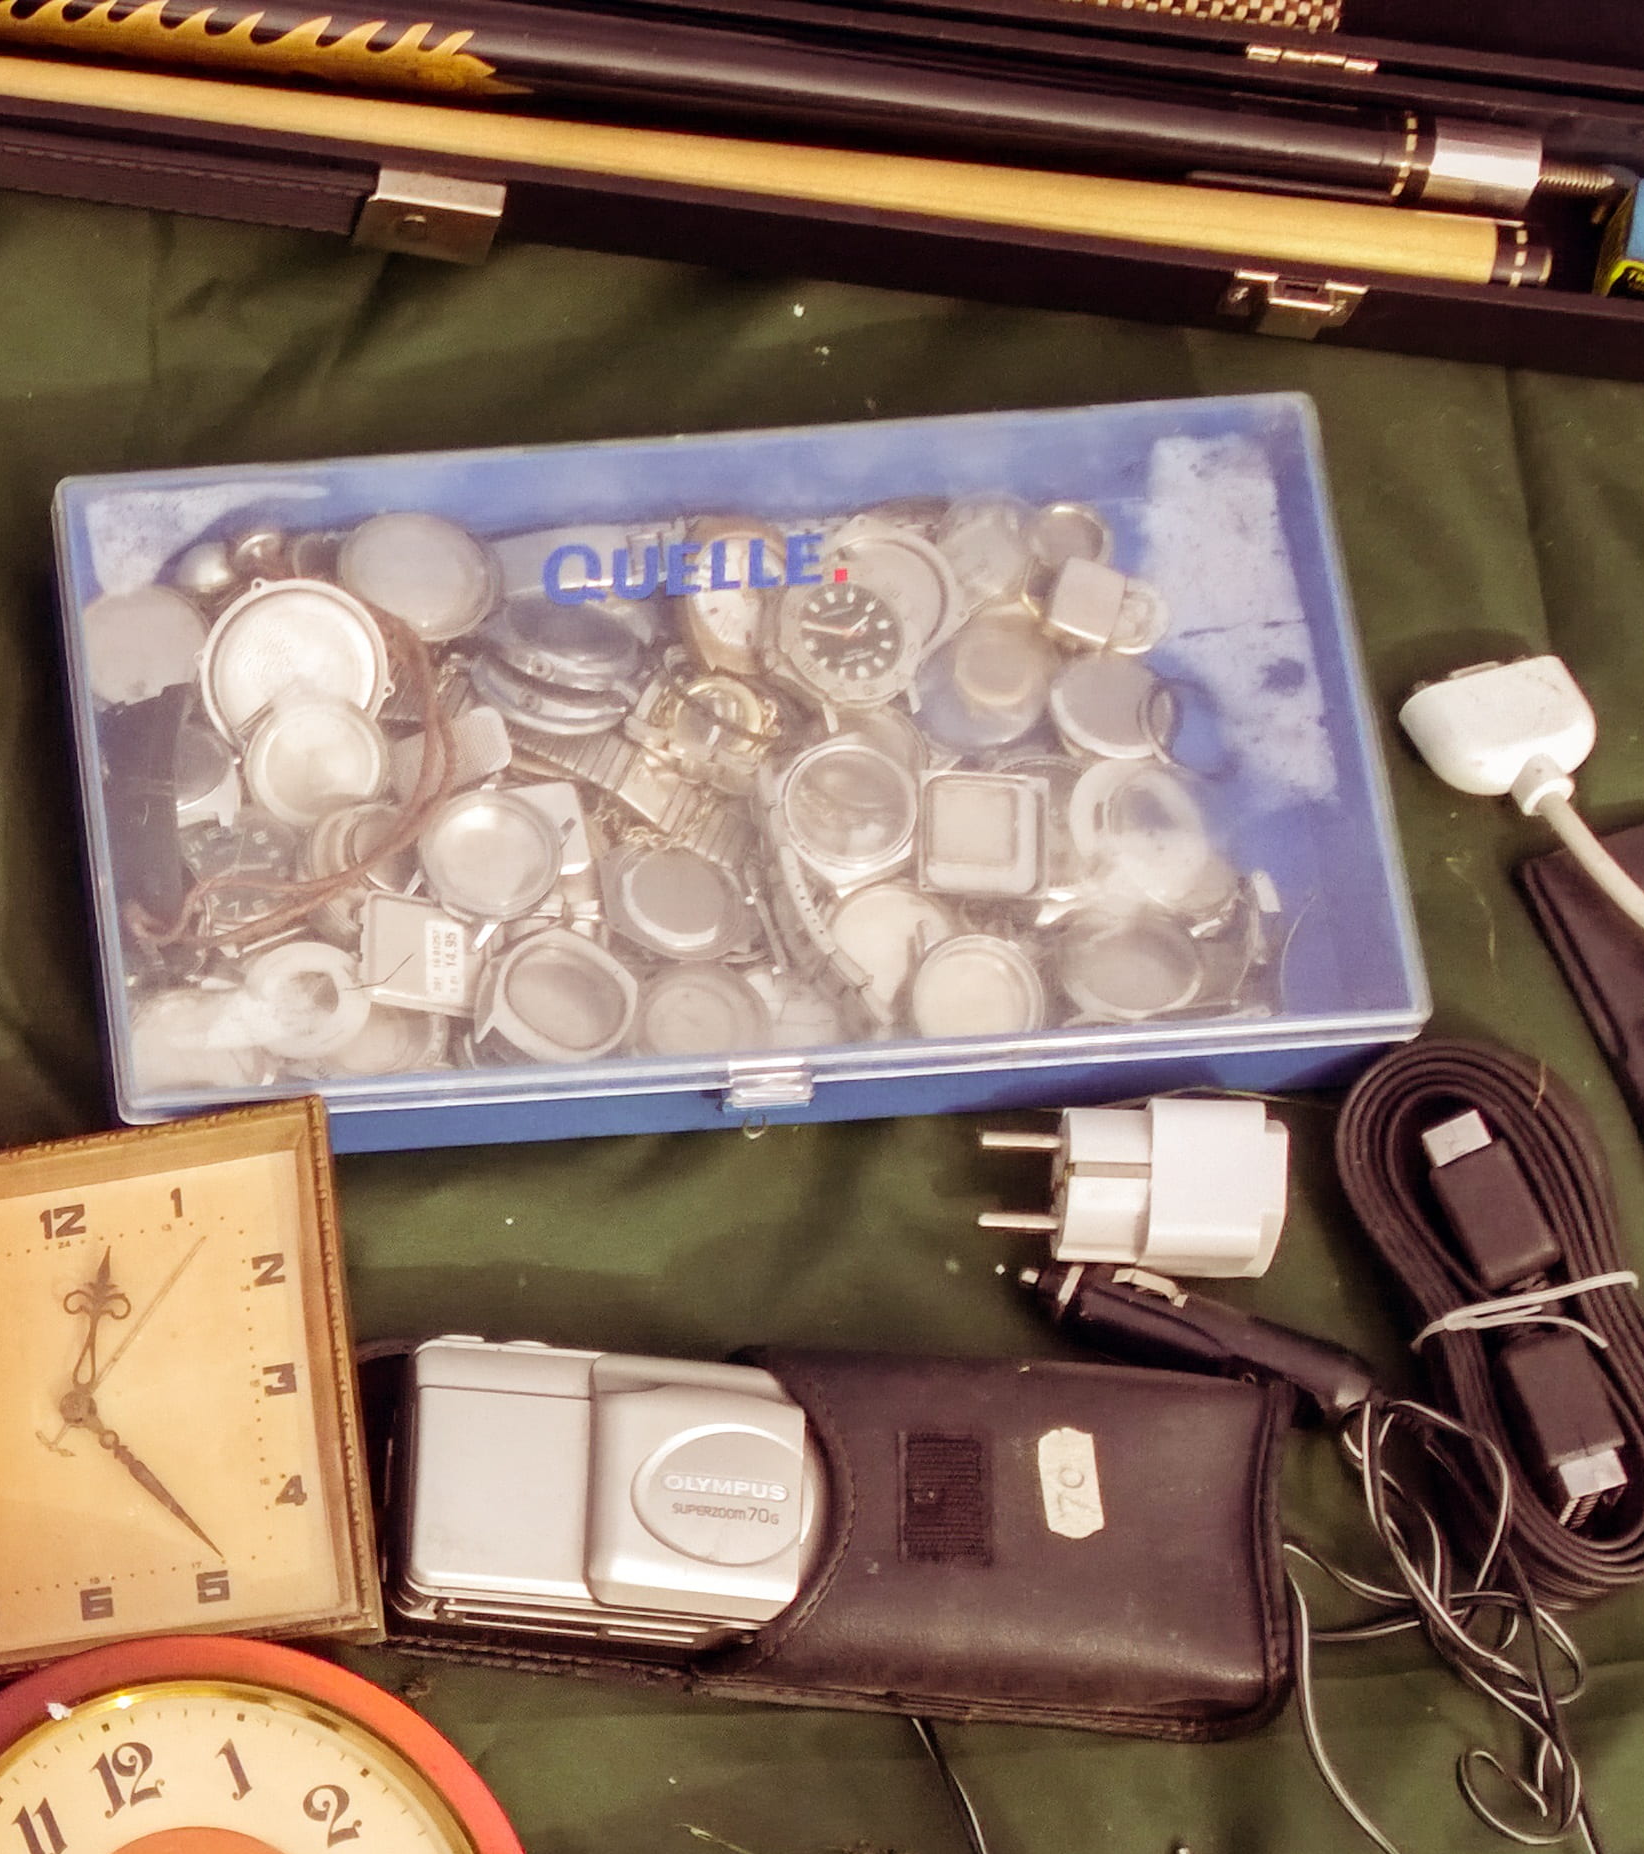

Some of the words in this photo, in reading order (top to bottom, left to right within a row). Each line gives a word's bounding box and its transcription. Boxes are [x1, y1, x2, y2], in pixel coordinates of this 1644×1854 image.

[169, 1187, 184, 1218] 1
[40, 1204, 85, 1239] 12
[251, 1253, 286, 1288] 2
[262, 1362, 297, 1396] 3
[274, 1474, 308, 1506] 4
[663, 1475, 788, 1502] OLYMPUS
[79, 1586, 114, 1621] 6
[195, 1570, 231, 1604] 5
[90, 1741, 166, 1820] 12
[215, 1738, 254, 1801] 1
[302, 1784, 362, 1849] 2
